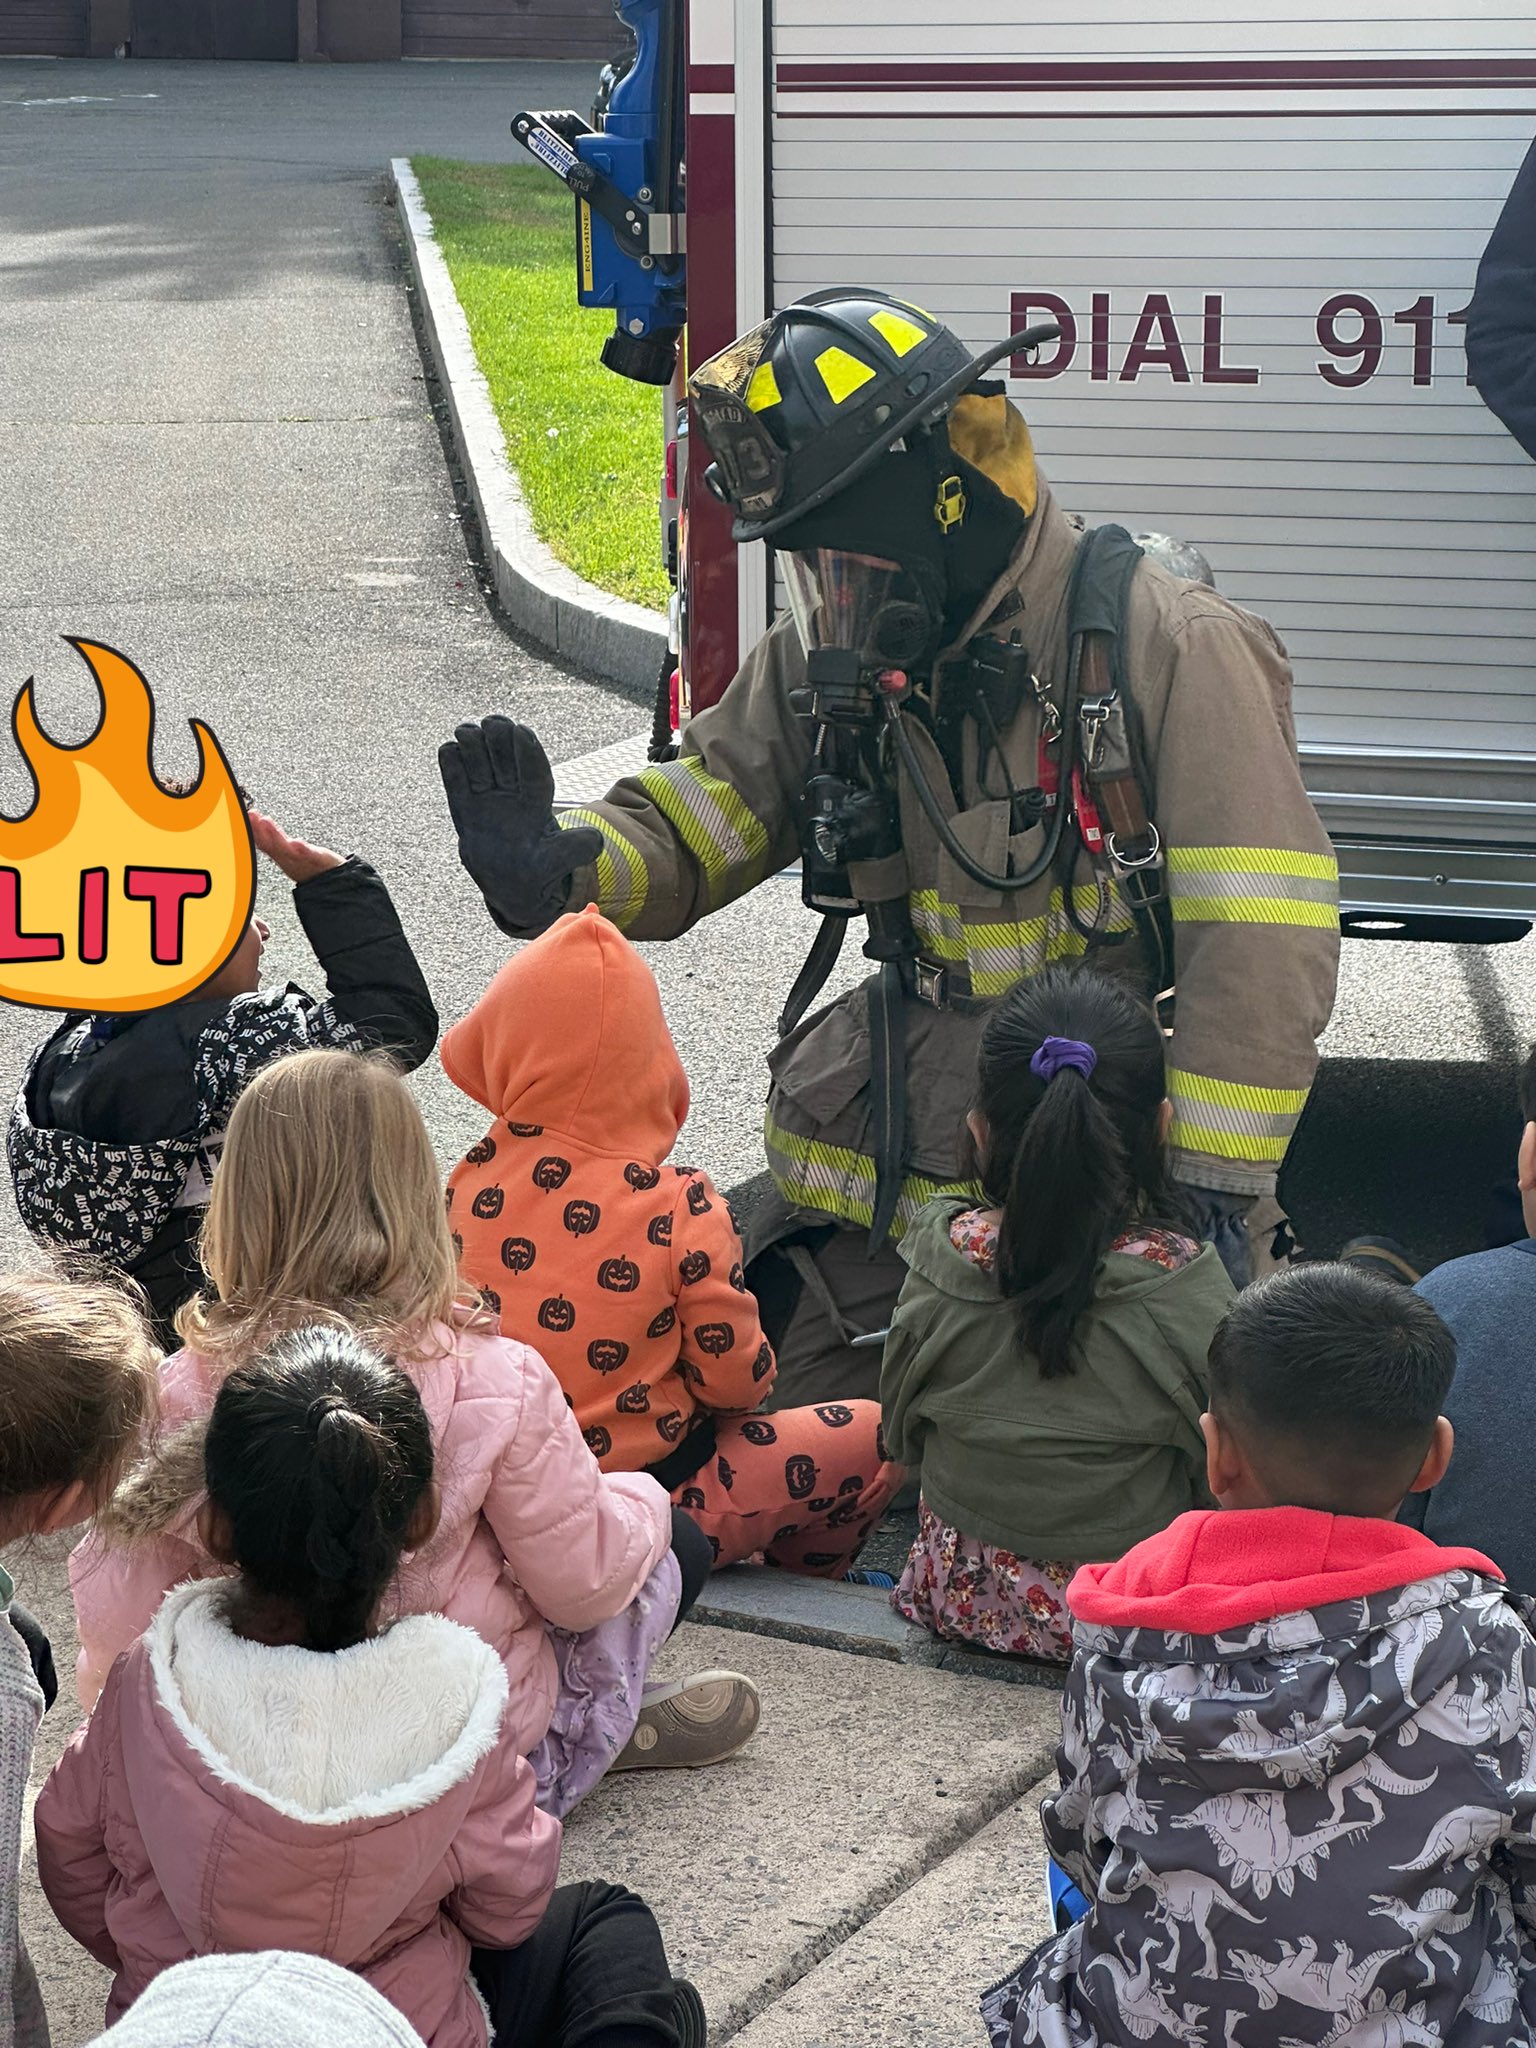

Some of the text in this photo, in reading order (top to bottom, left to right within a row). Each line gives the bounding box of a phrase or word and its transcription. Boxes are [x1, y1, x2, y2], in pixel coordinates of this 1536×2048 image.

[569, 176, 590, 192] PULL
[1009, 292, 1474, 388] DIAL 91
[104, 1151, 127, 1162] JUST
[74, 1193, 91, 1213] JUST
[80, 1214, 95, 1231] DO
